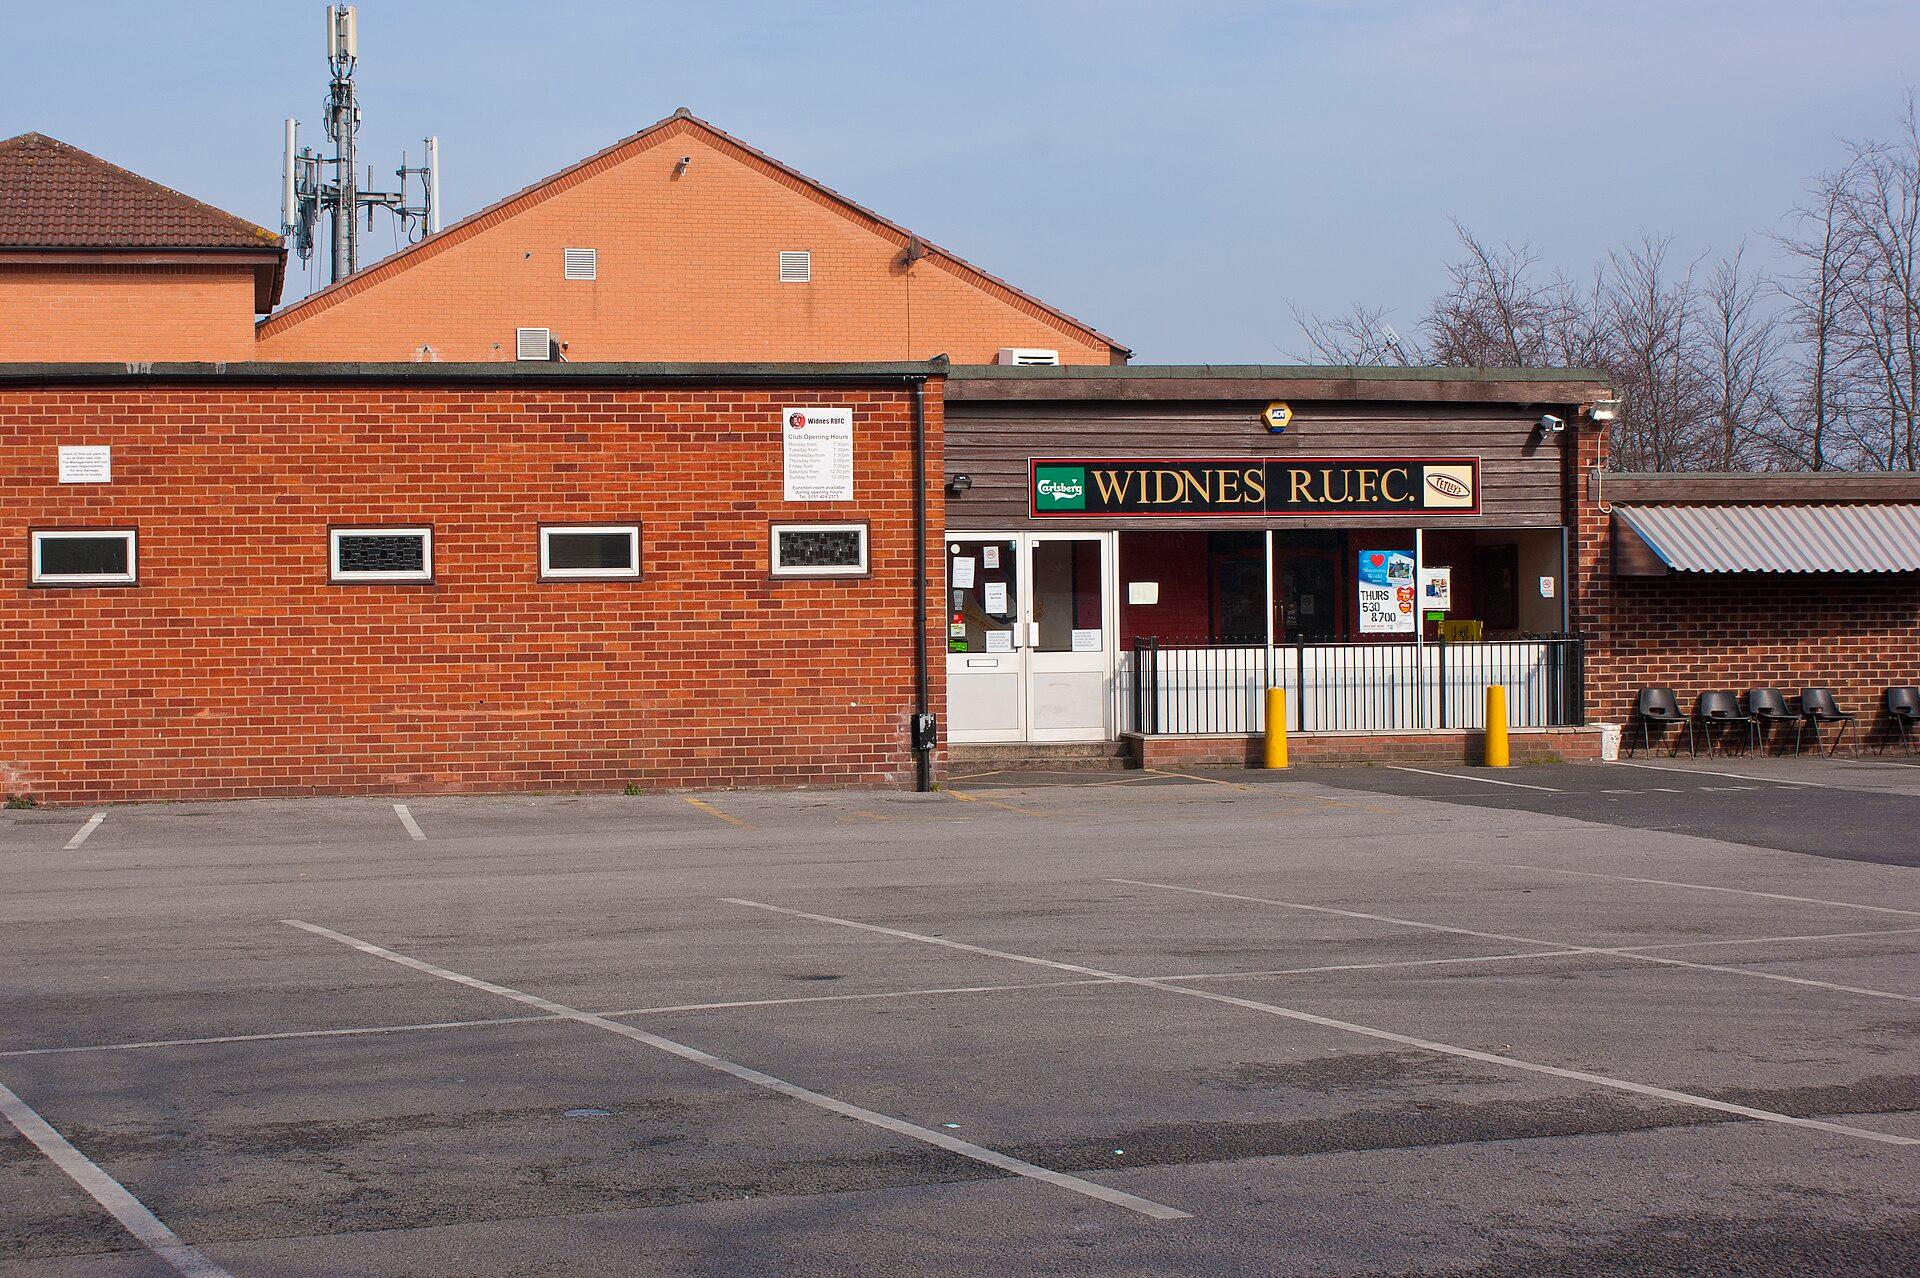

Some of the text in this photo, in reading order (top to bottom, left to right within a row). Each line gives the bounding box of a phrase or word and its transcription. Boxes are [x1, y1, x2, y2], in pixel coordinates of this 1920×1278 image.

[1272, 410, 1285, 418] ADT
[1038, 479, 1082, 496] Carlsberg
[1091, 468, 1415, 504] WIDNES R.U.F.C.
[1360, 590, 1390, 600] THURS
